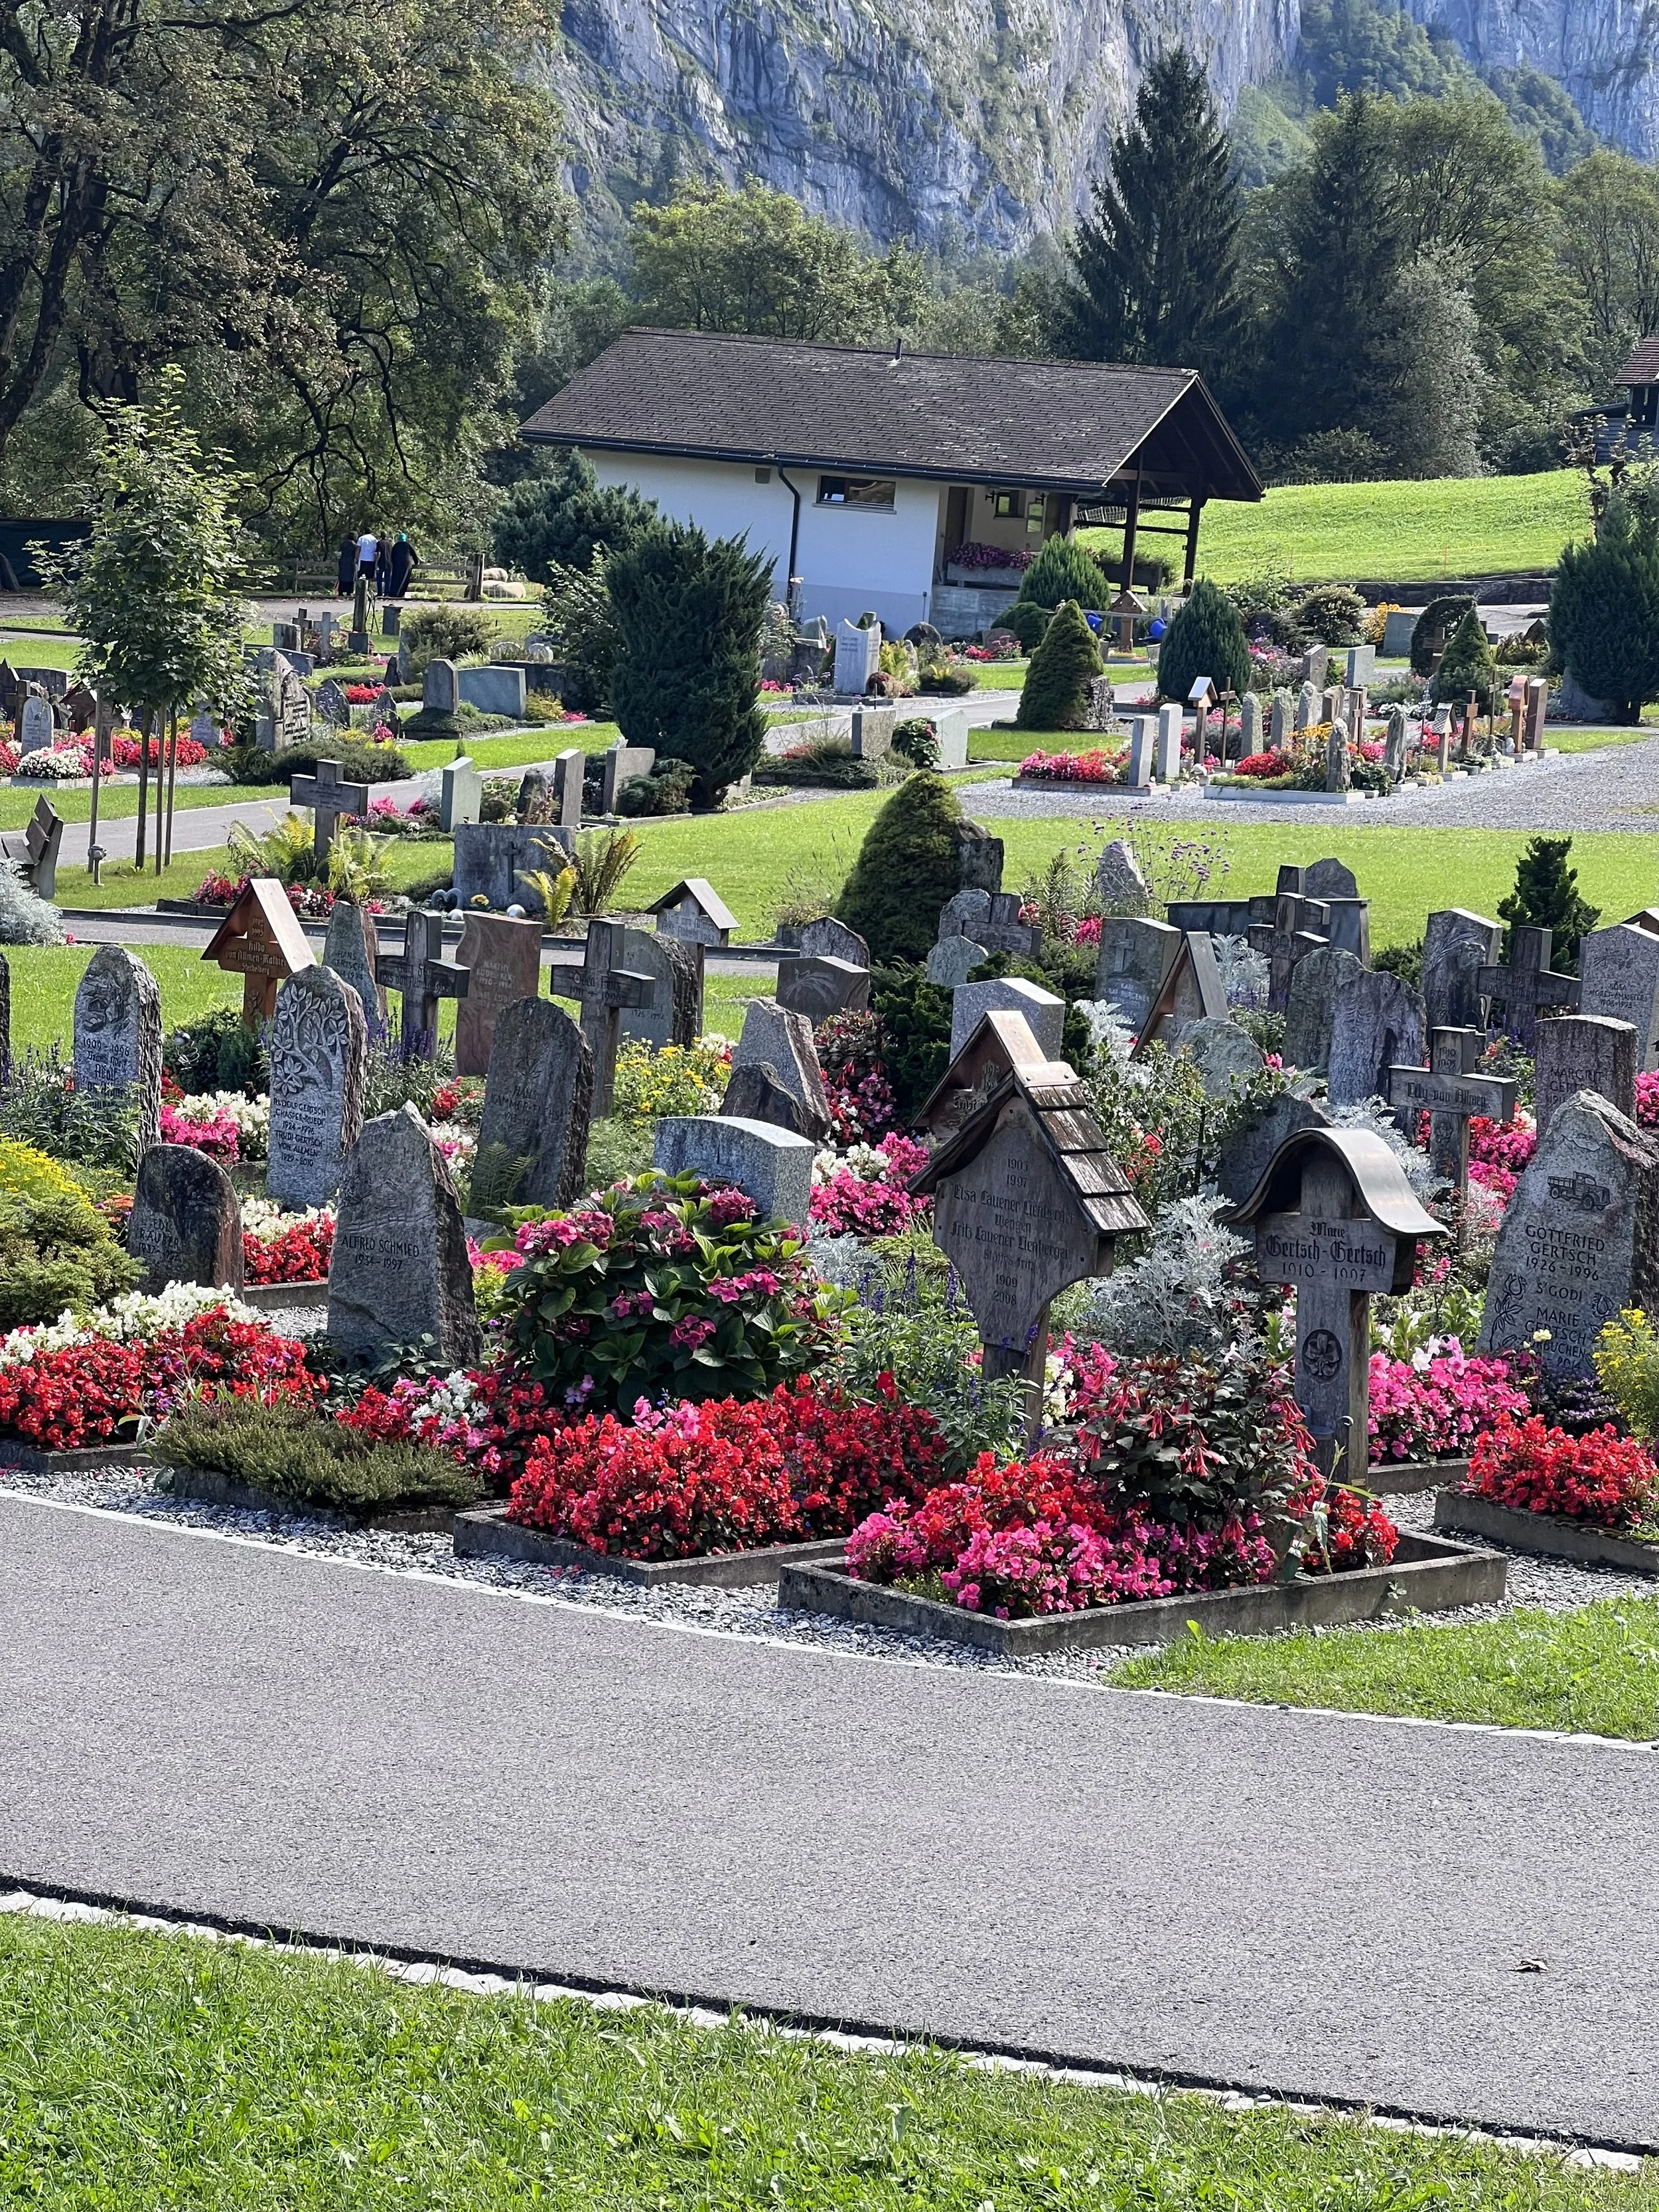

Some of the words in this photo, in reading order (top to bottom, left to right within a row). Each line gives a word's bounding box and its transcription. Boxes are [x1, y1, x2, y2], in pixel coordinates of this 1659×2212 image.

[332, 958, 364, 971] GERTSCH
[82, 1036, 102, 1051] 1909
[111, 1044, 129, 1057] 1996
[273, 1097, 298, 1110] RUDOLF
[299, 1103, 326, 1116] GERTSCH
[274, 1129, 294, 1142] TRUDI
[278, 1141, 292, 1151] VON
[293, 1144, 319, 1157] ALLMEN
[1006, 1174, 1028, 1188] 1997
[954, 1183, 977, 1203] Elsa
[995, 1213, 1032, 1234] Wengen
[1309, 1221, 1346, 1239] Marie
[139, 1227, 179, 1249] RAUBER
[340, 1234, 376, 1251] ALFRED
[379, 1238, 420, 1258] SCHMIED
[1526, 1224, 1605, 1252] GOTTFRIED
[1530, 1241, 1597, 1266] GERTSCH
[995, 1273, 1018, 1289] 1909
[1282, 1262, 1315, 1278] 1910
[1334, 1267, 1367, 1284] 1997
[993, 1290, 1017, 1306] 2008
[1536, 1306, 1581, 1327] MARIE
